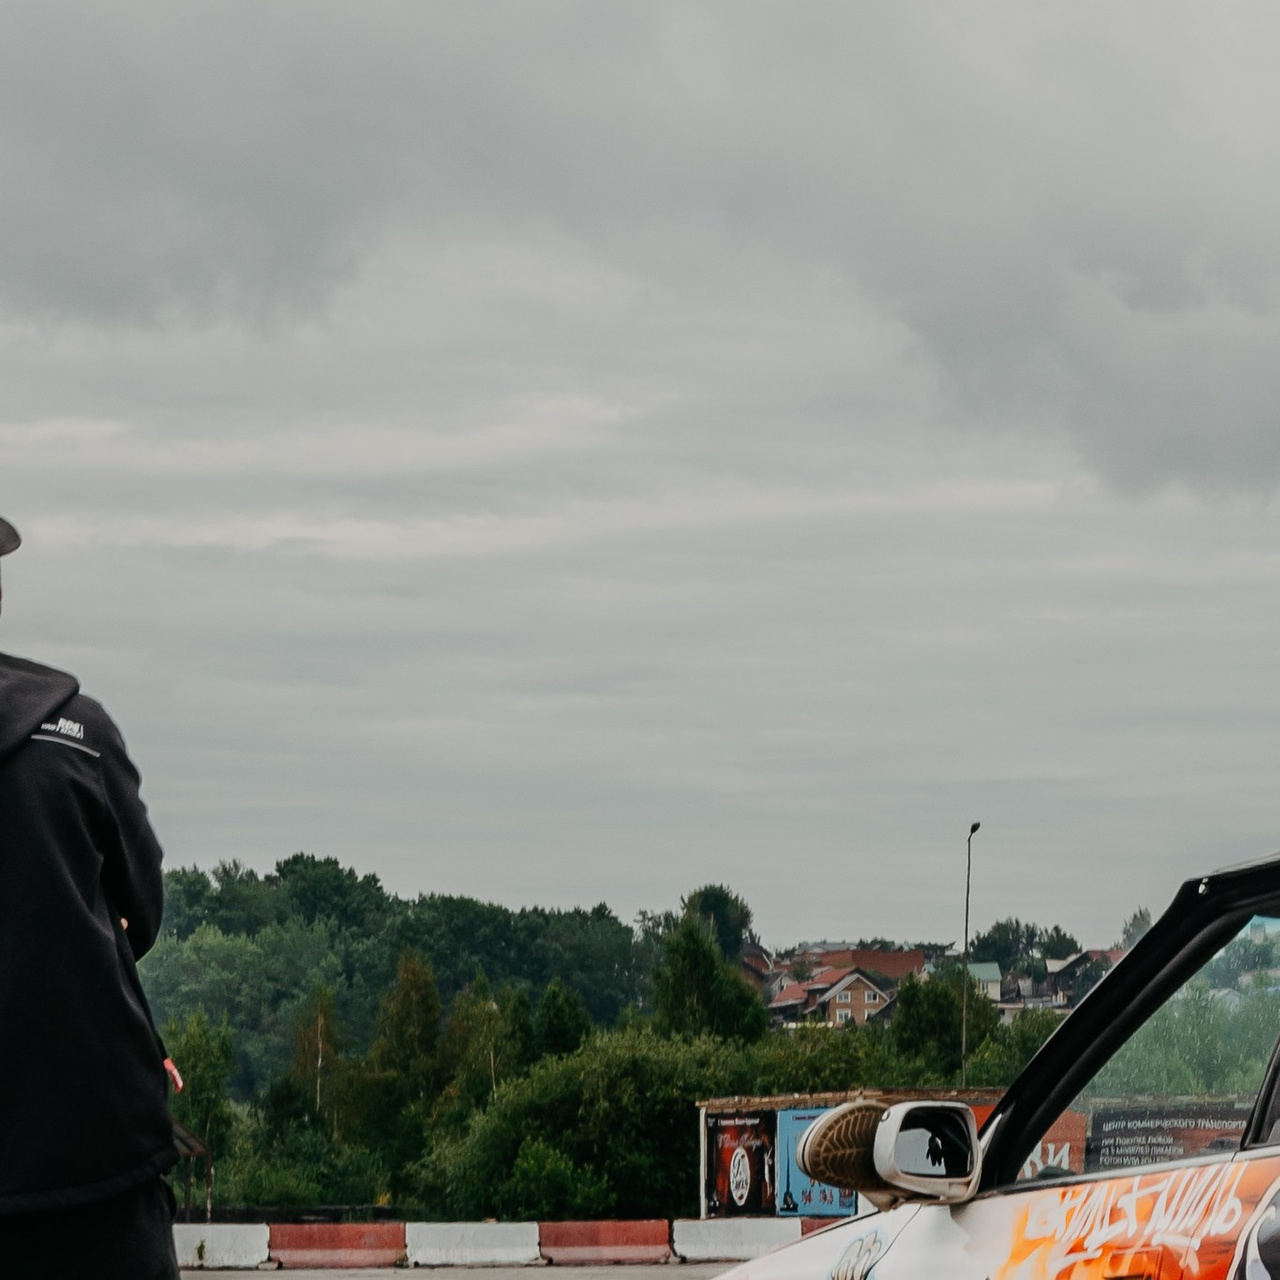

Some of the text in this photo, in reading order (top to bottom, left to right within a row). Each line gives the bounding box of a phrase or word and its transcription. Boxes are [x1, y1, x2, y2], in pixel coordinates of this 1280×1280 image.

[1102, 1118, 1247, 1132] ЦЕНТР КОММЕРЧЕСКОГО ТРАНСПОРТА
